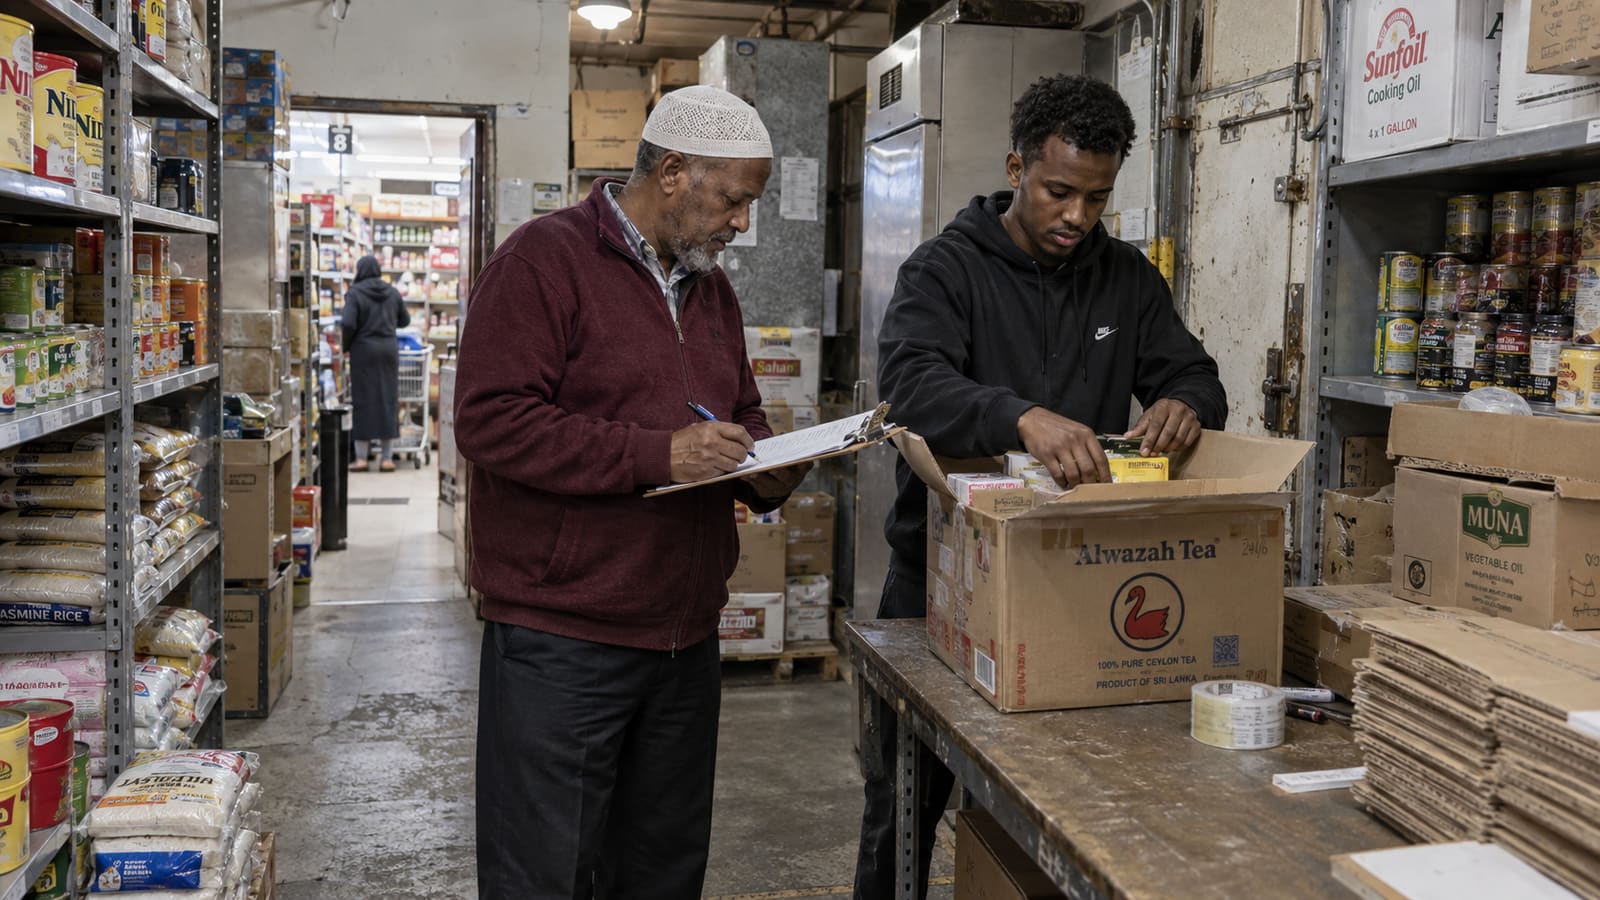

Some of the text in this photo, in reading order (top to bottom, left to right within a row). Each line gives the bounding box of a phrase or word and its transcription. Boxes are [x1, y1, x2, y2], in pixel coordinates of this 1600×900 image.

[1367, 74, 1420, 105] Cooking Oil
[1368, 117, 1417, 139] 4 x 1 GALLON
[334, 133, 347, 152] 8
[756, 360, 794, 374] Sahan
[1467, 504, 1524, 537] MUNA
[1075, 539, 1217, 565] Alwazah Tea
[1465, 551, 1524, 574] VEGETABLE OIL
[0, 608, 84, 622] ASMINE RICE
[1098, 656, 1197, 670] 100% PURE CEYLON TEA
[1096, 678, 1137, 689] PRODUCT
[1140, 678, 1152, 686] OF
[1154, 676, 1167, 685] SRI
[1169, 674, 1197, 684] LANKA
